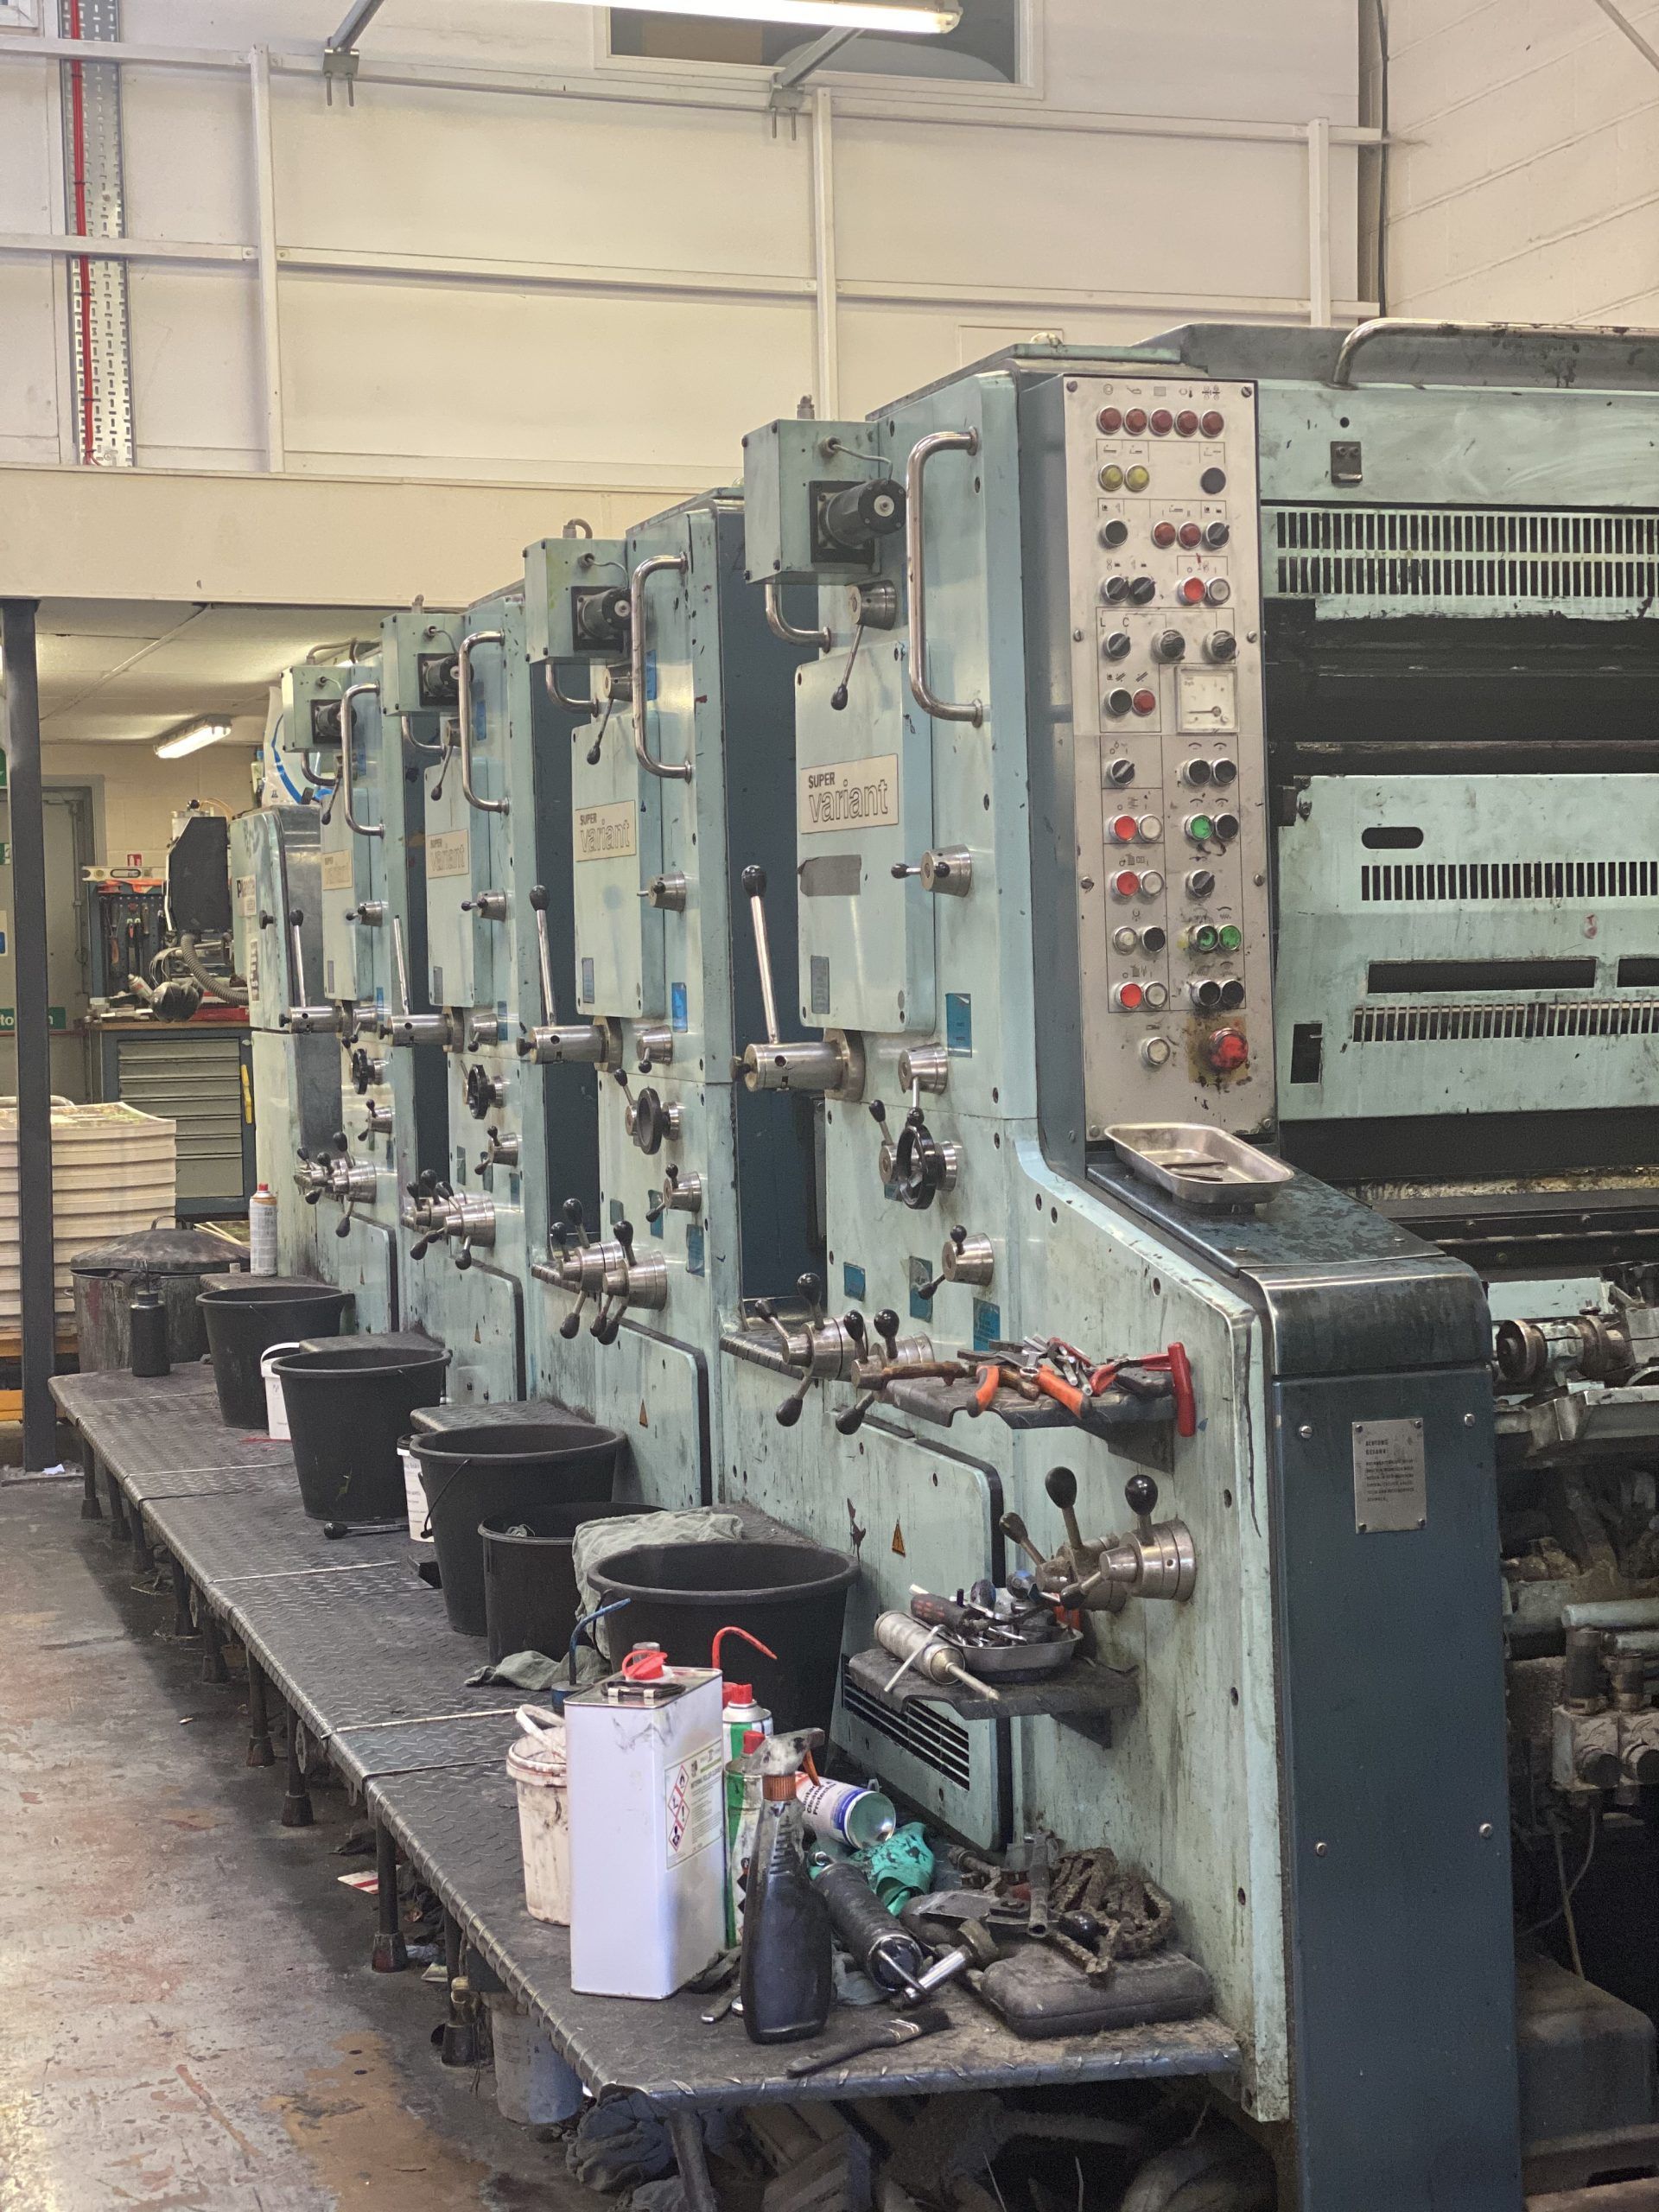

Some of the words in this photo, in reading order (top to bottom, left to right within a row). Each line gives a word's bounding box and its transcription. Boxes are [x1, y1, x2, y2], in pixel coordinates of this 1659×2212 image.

[1100, 617, 1107, 627] L
[1122, 617, 1129, 627] C
[808, 772, 836, 790] SUPER
[809, 779, 888, 823] variant
[580, 812, 597, 826] SUPER
[580, 817, 630, 853] variant
